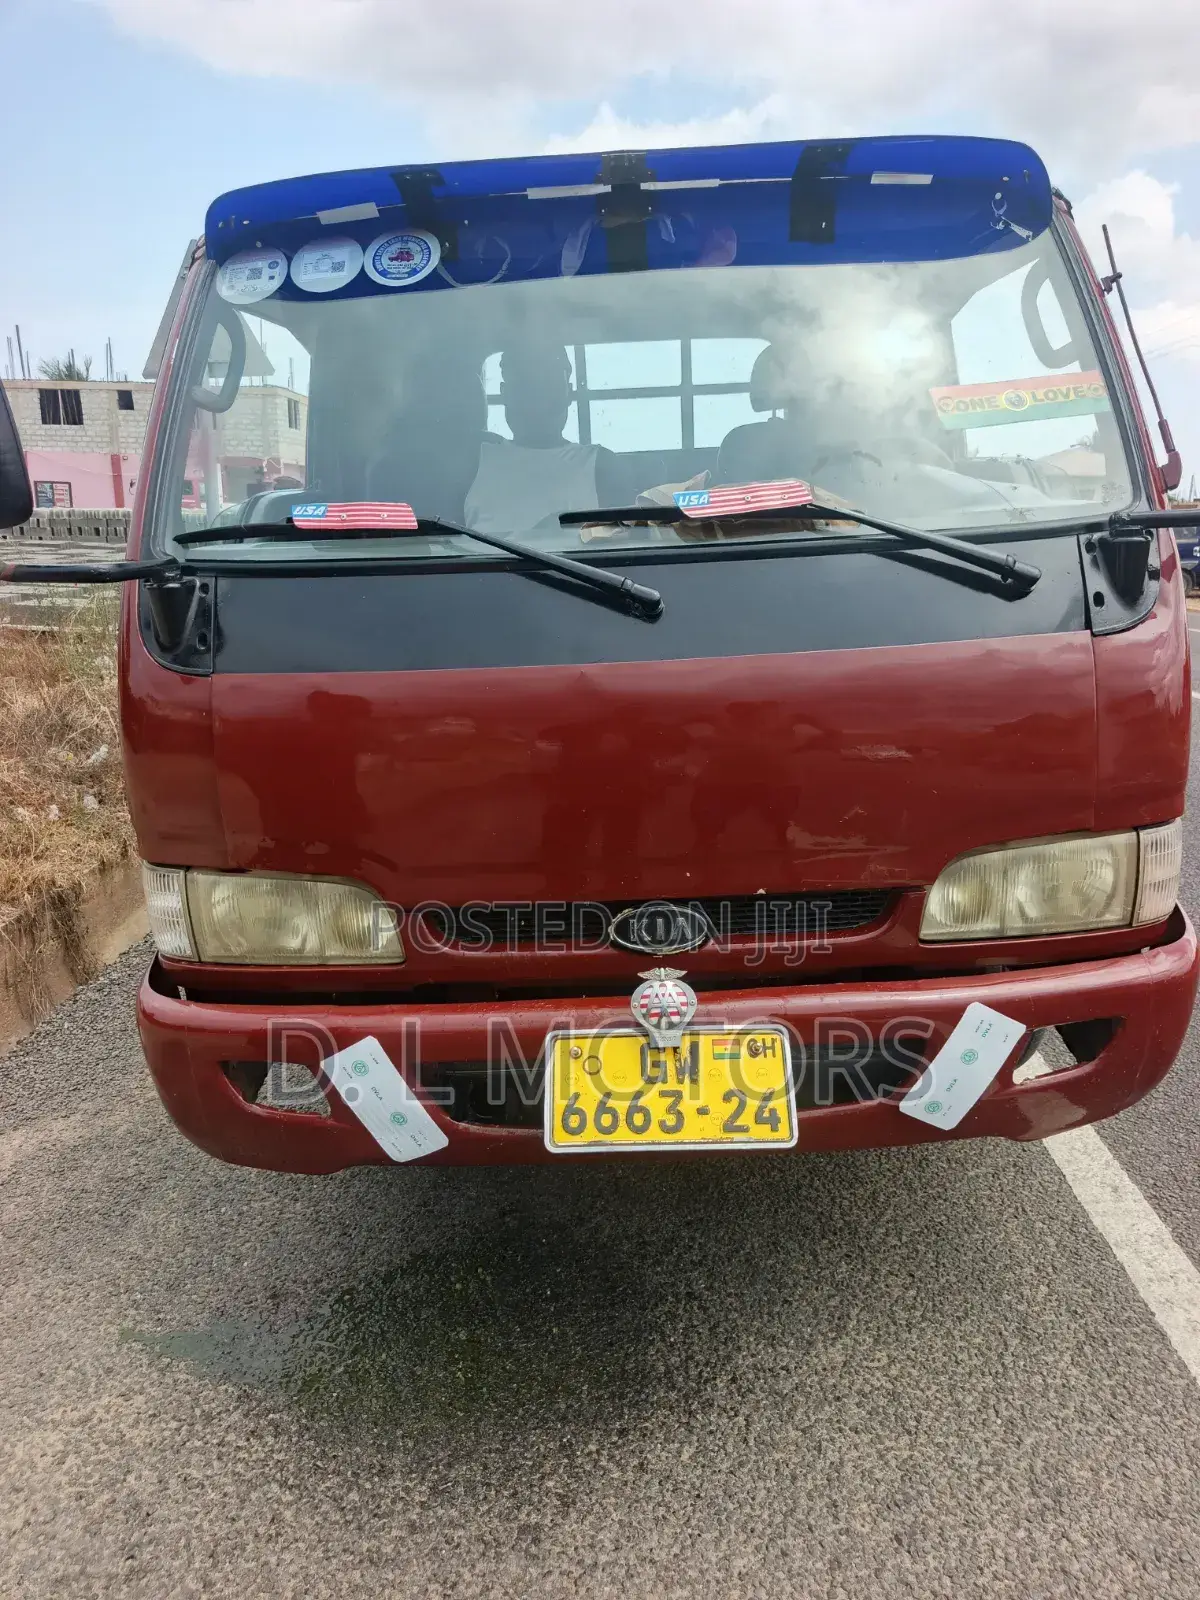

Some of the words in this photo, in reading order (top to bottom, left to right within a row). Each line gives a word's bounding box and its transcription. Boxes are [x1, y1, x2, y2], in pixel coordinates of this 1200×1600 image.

[955, 395, 1000, 413] ONE
[1030, 384, 1084, 404] LOVE
[292, 505, 327, 516] USA
[679, 493, 709, 507] USA
[629, 917, 692, 942] KIA
[640, 1040, 699, 1084] GW
[561, 1088, 781, 1136] 6663-24
